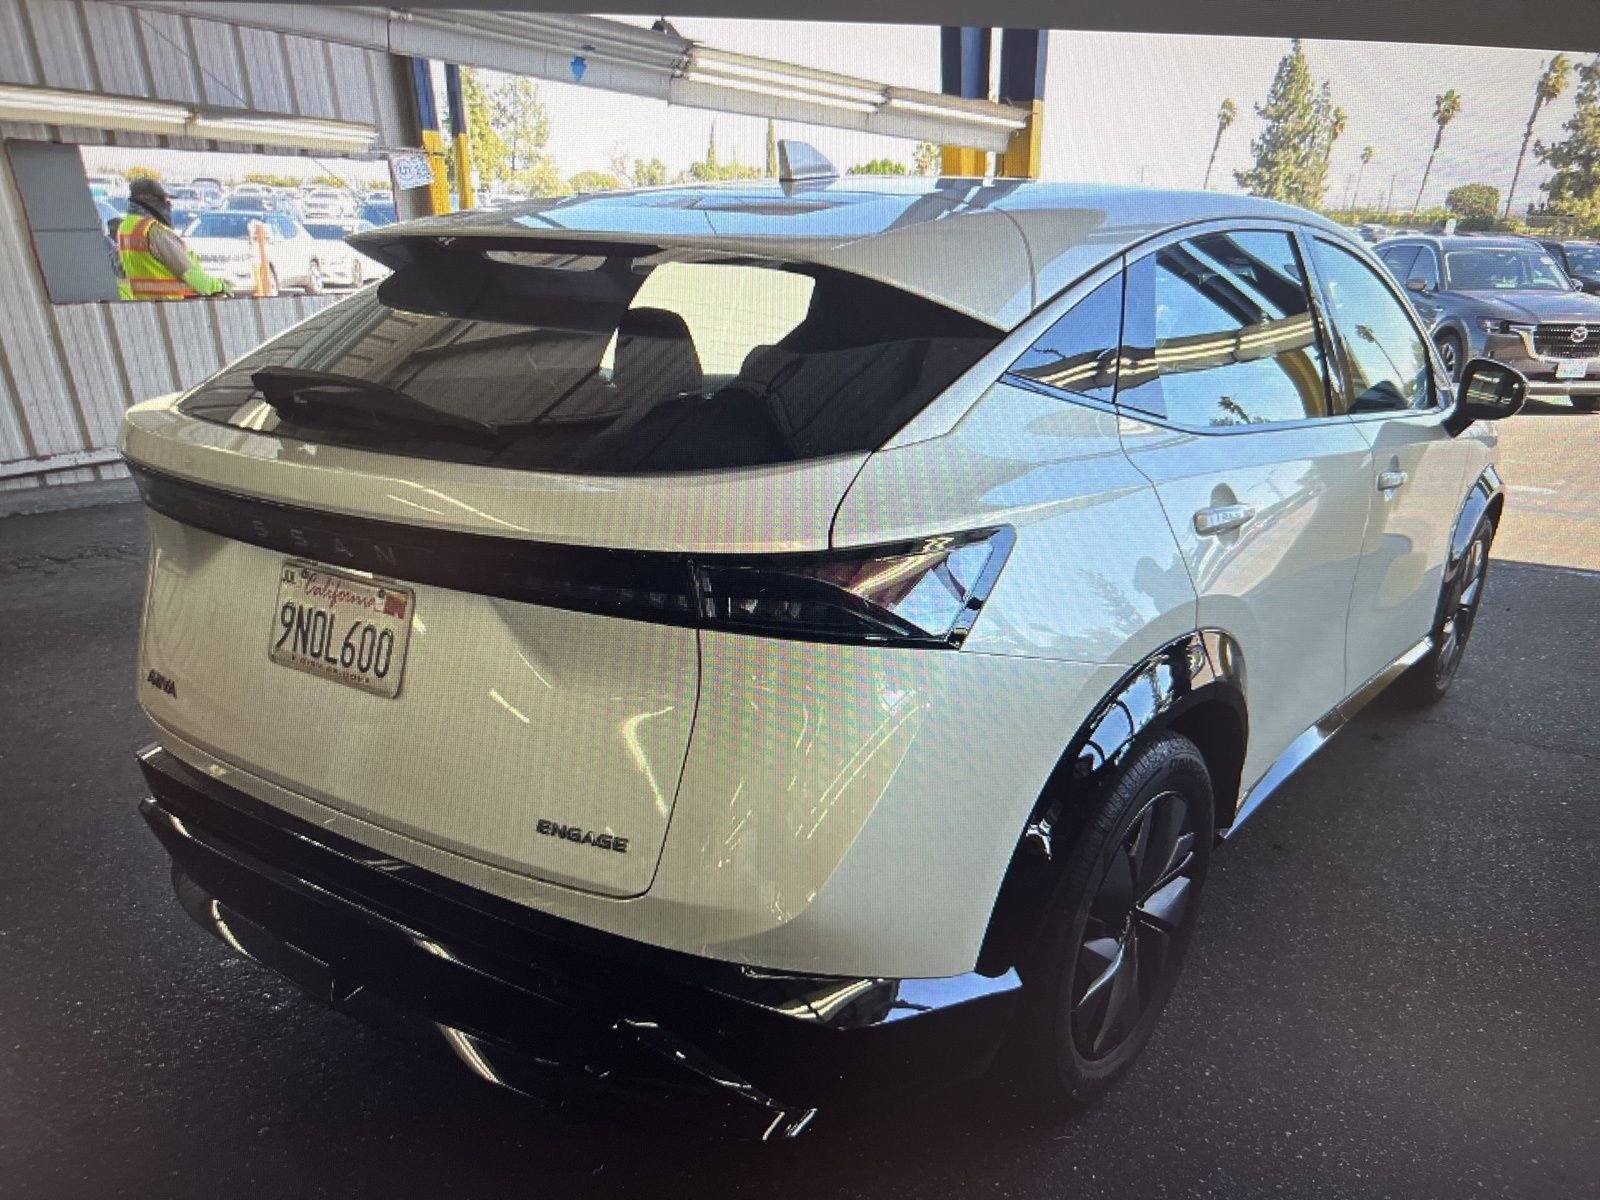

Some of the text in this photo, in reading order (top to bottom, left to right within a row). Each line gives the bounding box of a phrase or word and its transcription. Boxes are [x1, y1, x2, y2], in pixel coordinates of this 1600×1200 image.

[305, 572, 376, 608] California
[275, 601, 394, 678] 9NOL600
[536, 819, 629, 853] ENGAGE
